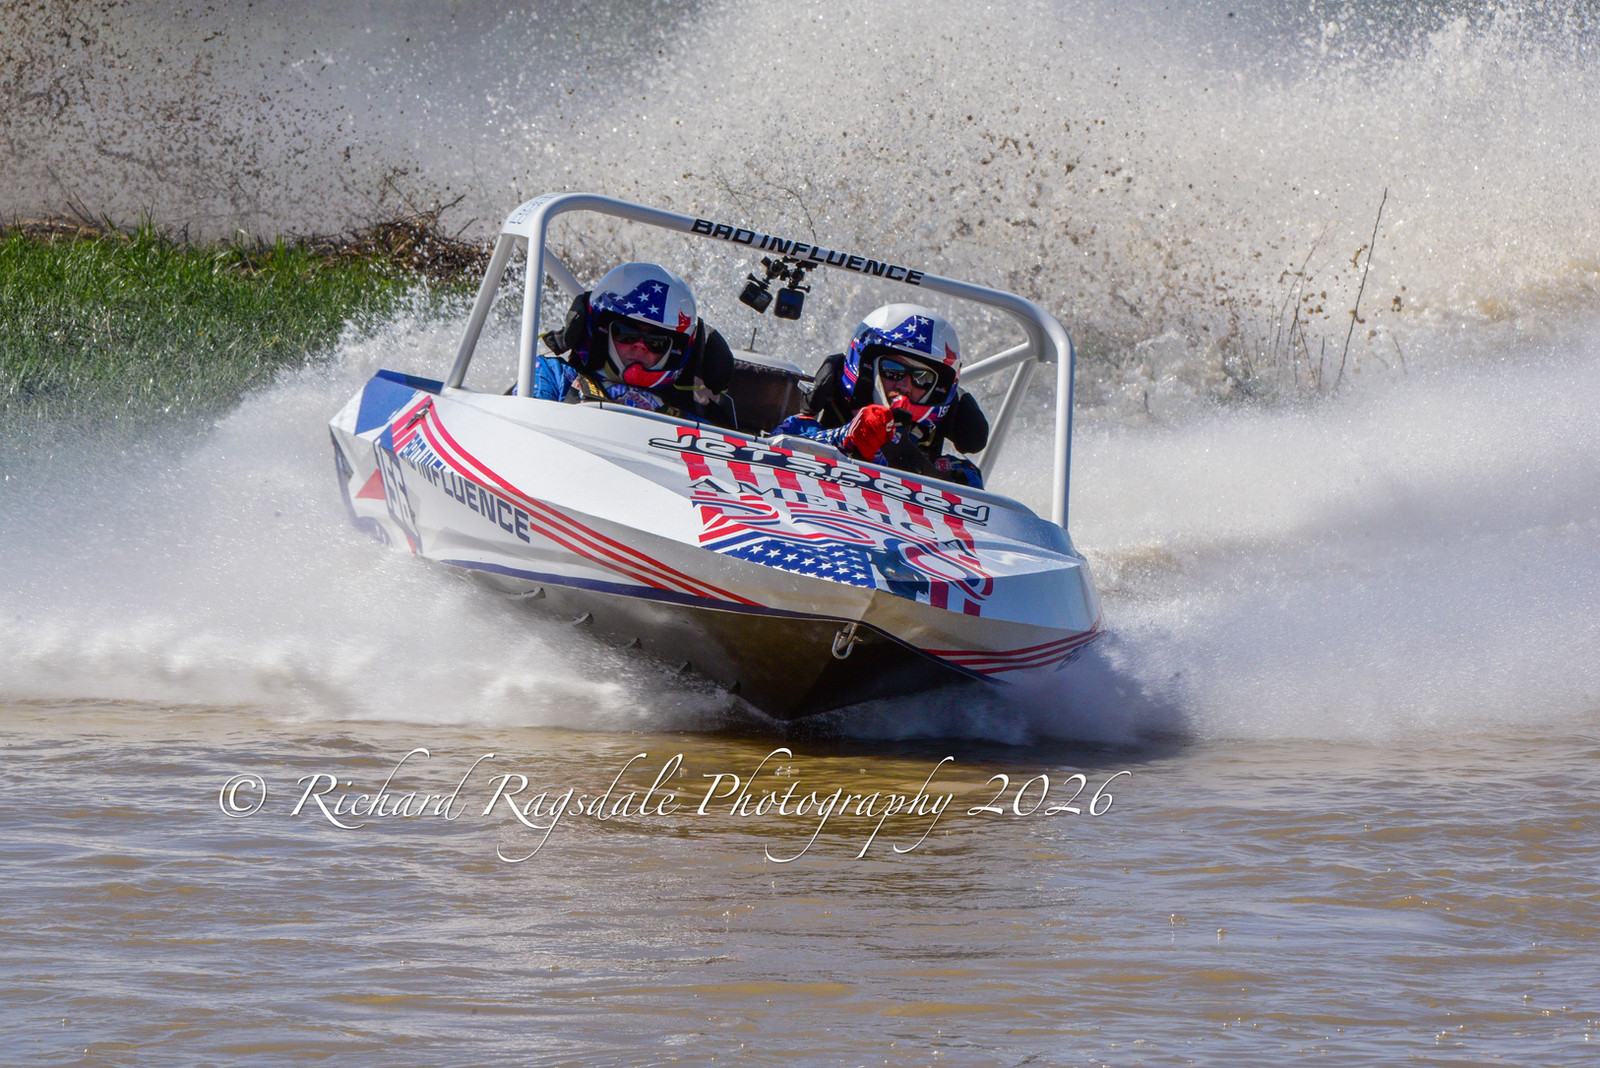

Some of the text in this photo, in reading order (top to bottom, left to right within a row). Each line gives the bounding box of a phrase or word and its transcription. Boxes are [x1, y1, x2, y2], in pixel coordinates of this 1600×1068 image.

[691, 218, 924, 286] BAD INFLUENCE
[416, 448, 530, 543] INFLUENCE
[687, 478, 977, 555] AMERICA
